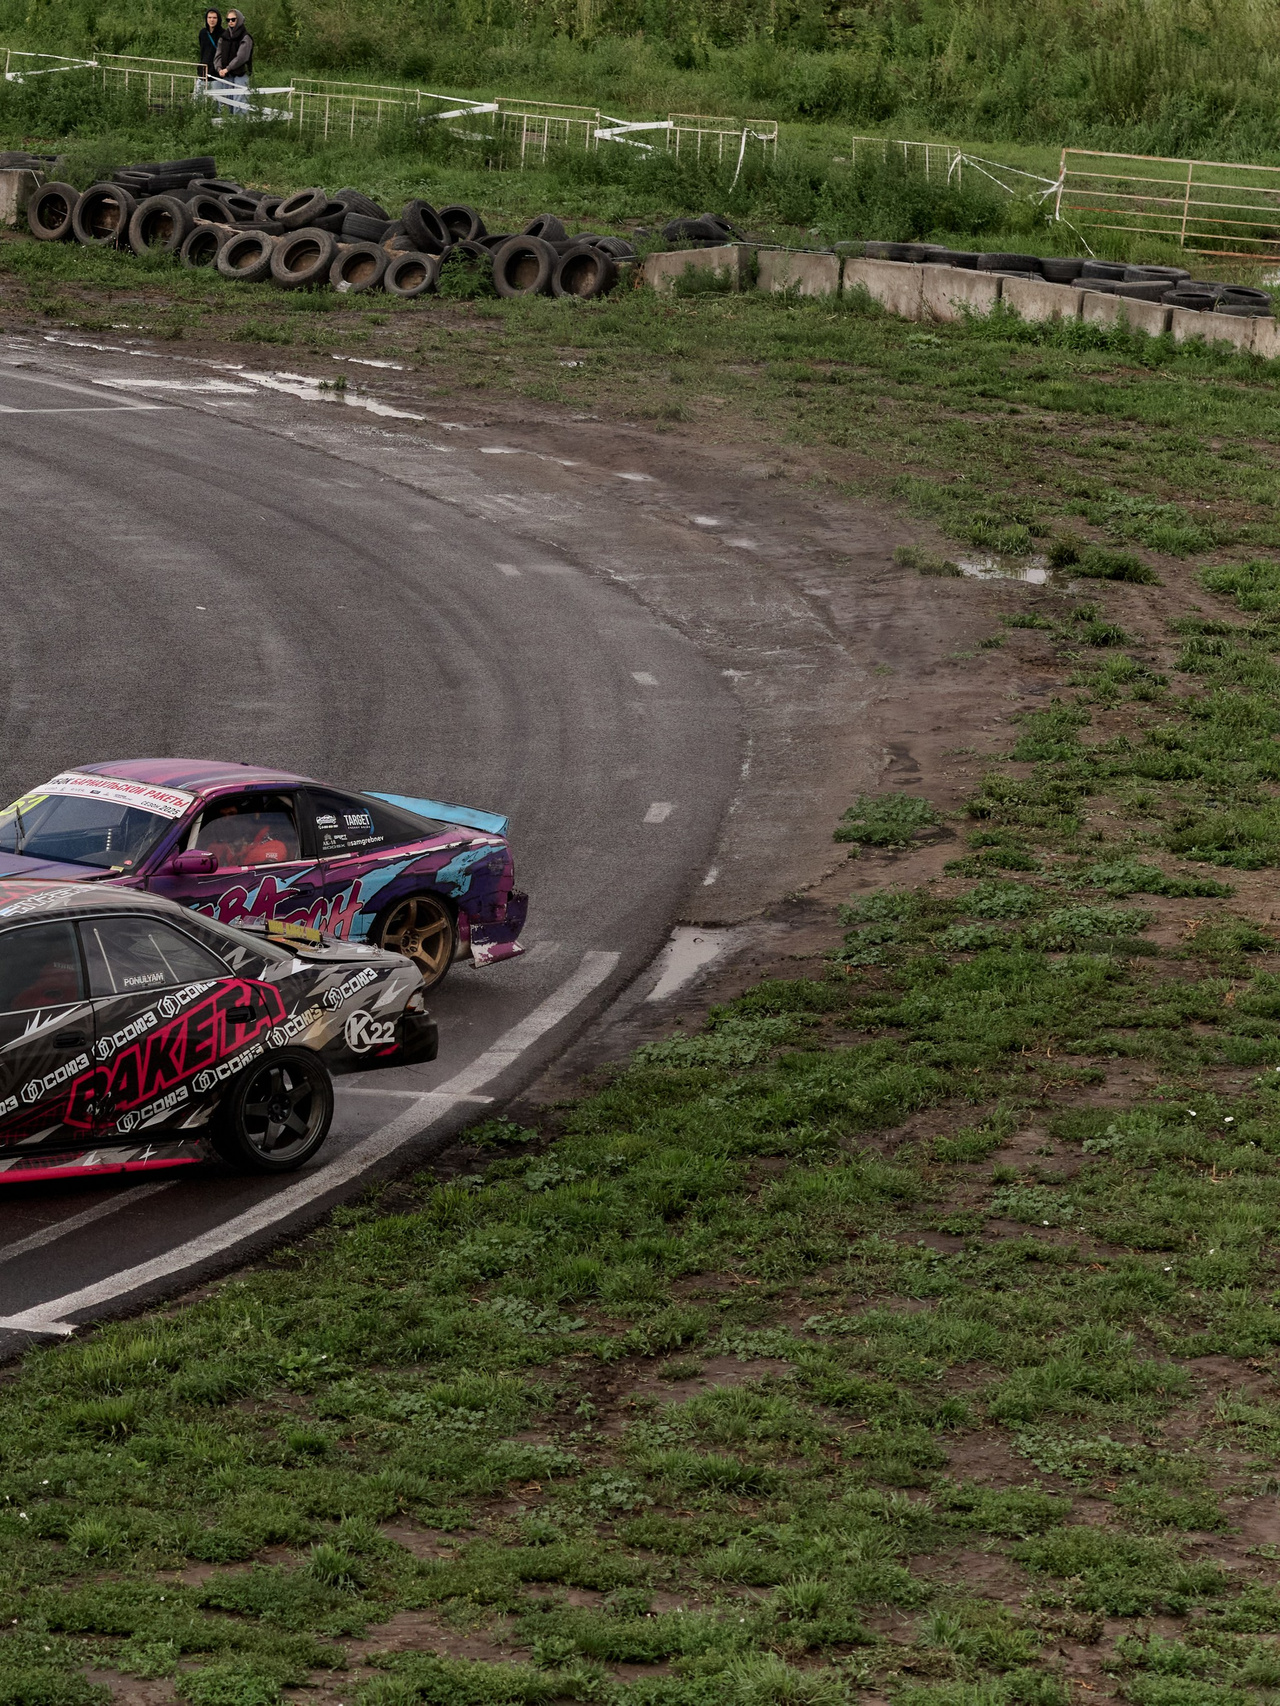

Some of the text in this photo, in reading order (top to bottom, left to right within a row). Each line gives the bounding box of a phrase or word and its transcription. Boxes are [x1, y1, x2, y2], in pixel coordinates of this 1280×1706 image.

[145, 788, 190, 808] РАКЕТЫ
[158, 804, 181, 815] 2025
[343, 814, 370, 826] TARGET
[123, 972, 165, 987] PONULYAM
[341, 967, 378, 1000] СОЮЗ
[114, 1011, 159, 1048] СОЮЗ
[43, 1053, 91, 1090] СОЮЗ
[140, 1085, 189, 1120] СОЮЗ
